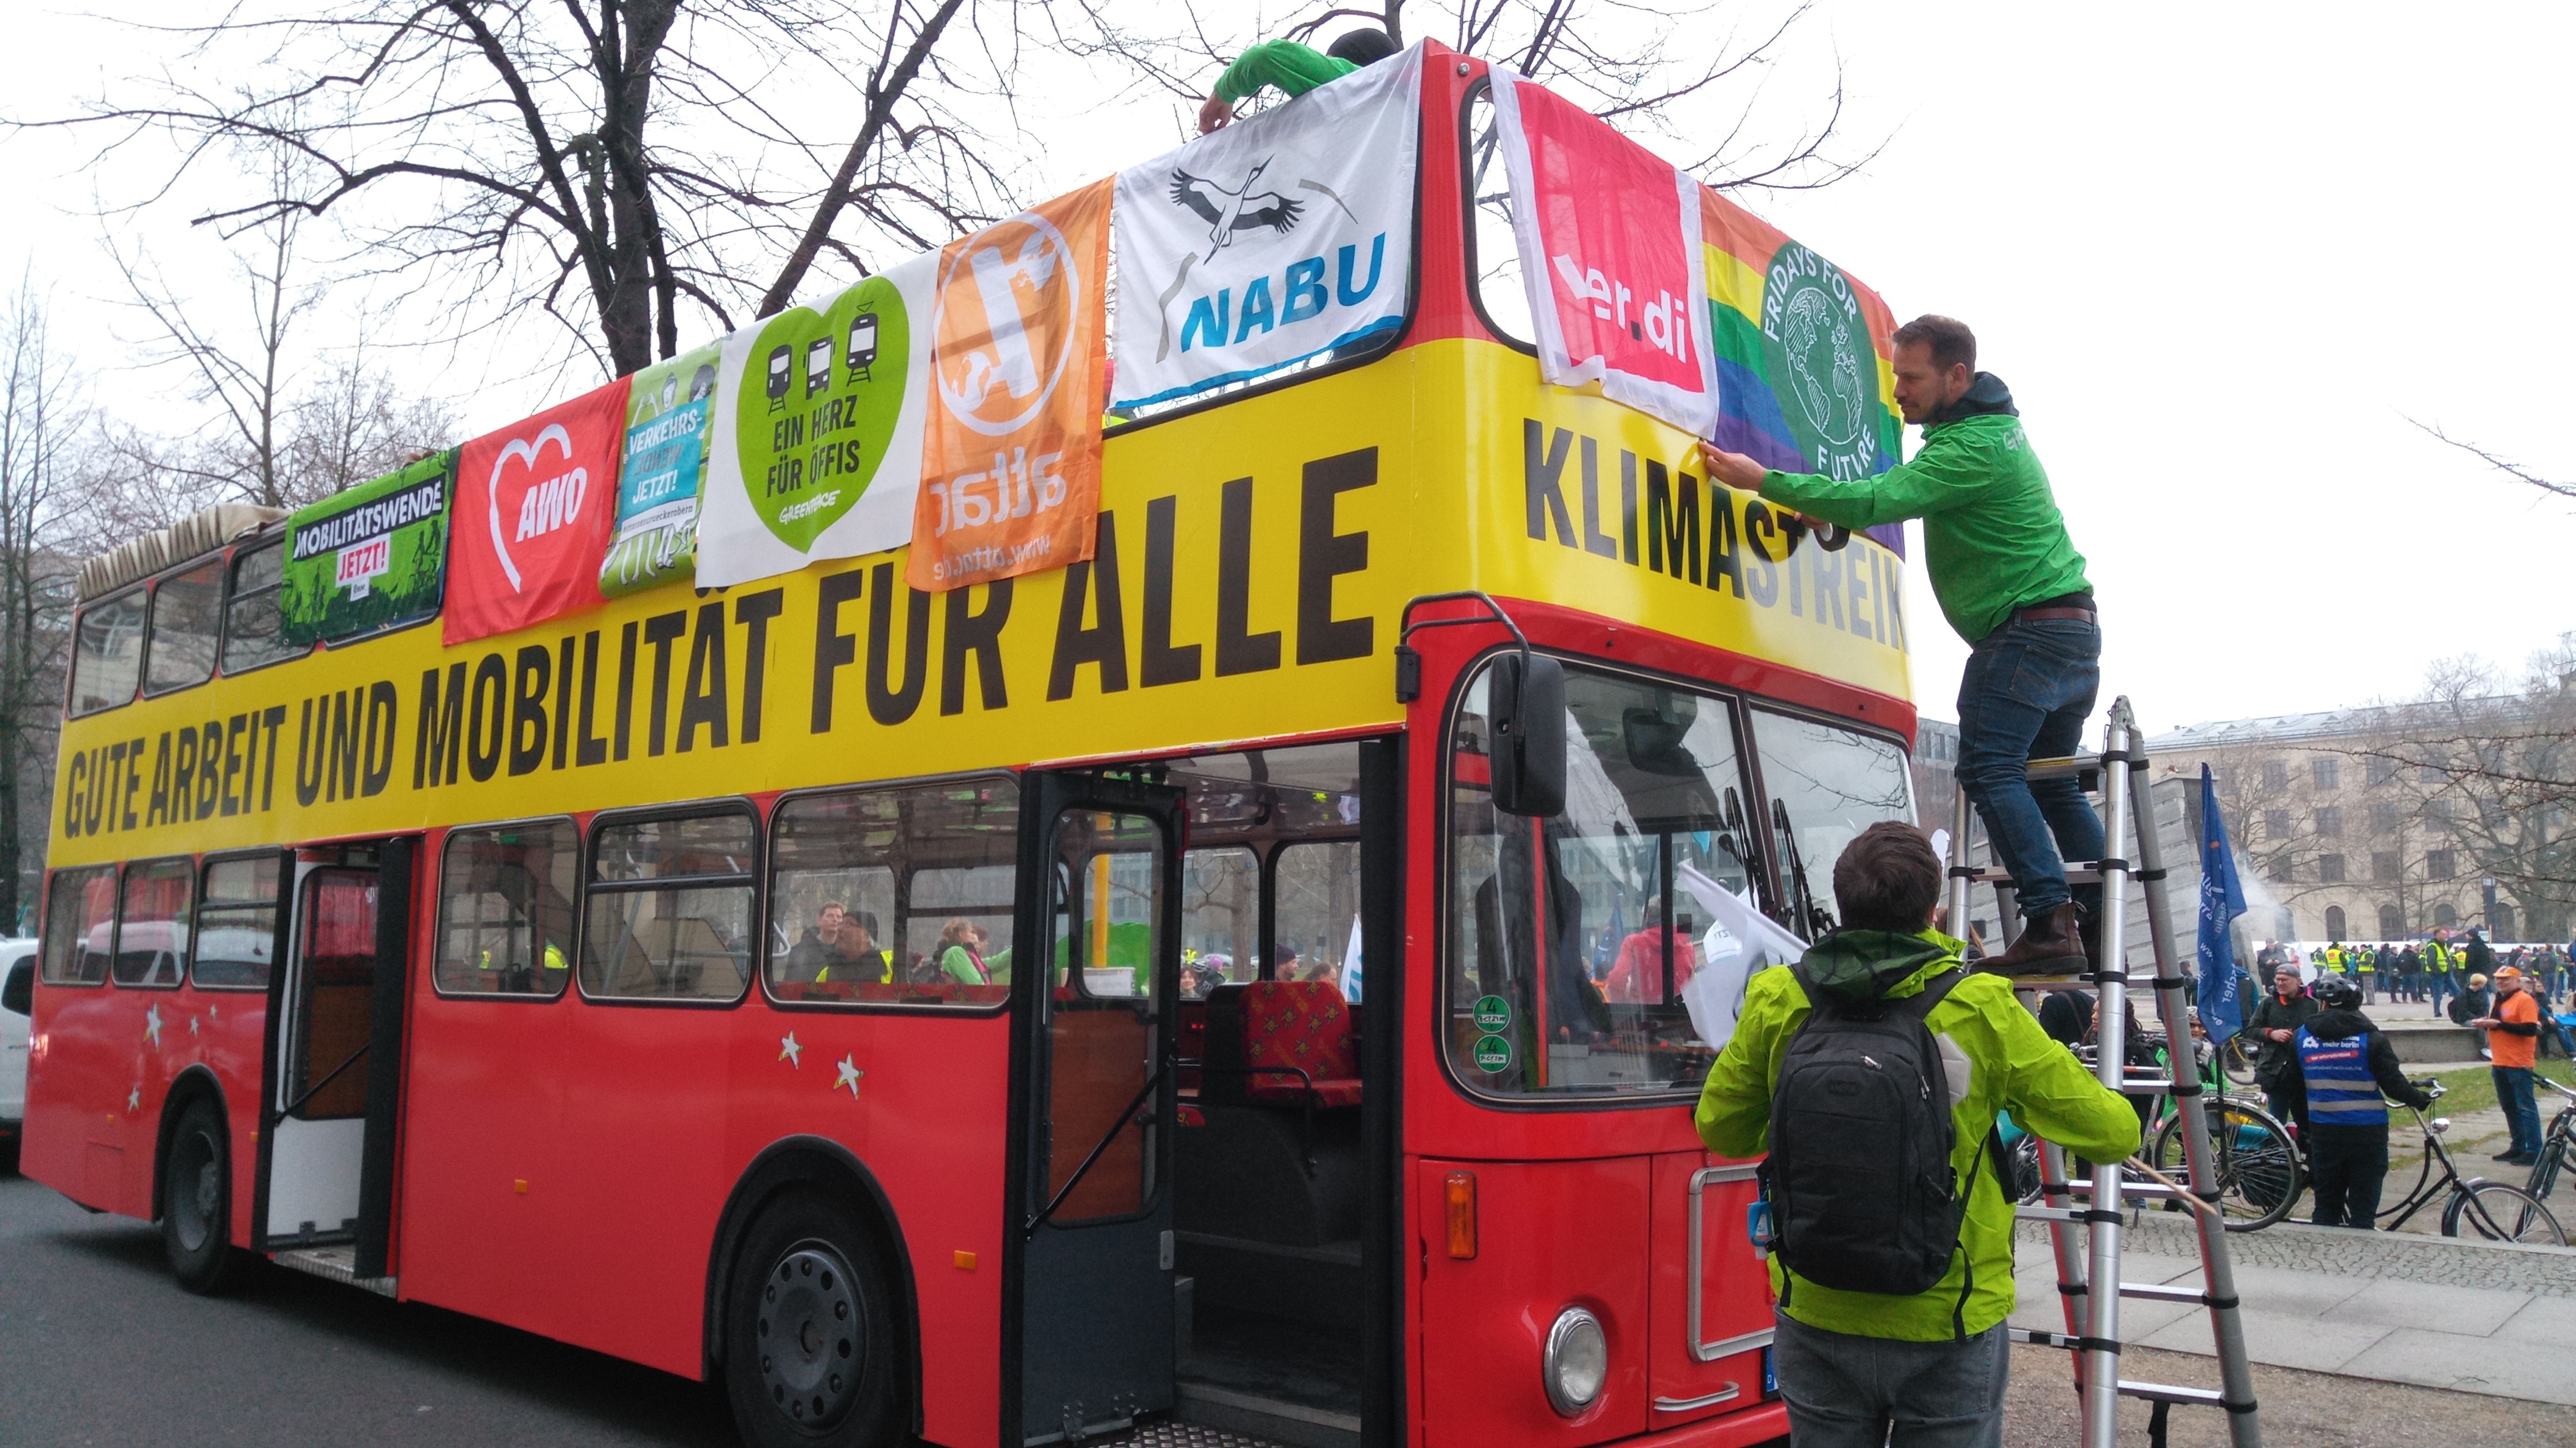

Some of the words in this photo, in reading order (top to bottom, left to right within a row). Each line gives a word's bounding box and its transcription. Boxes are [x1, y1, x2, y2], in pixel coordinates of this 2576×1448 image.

[1180, 231, 1387, 354] NABU
[1552, 254, 1686, 364] ver.di
[1764, 247, 1817, 343] FRIDAYS
[1822, 259, 1858, 323] FOR
[628, 413, 703, 456] VERKEHRS-
[772, 414, 804, 454] EIN
[811, 394, 858, 441] HERZ
[632, 469, 678, 504] JETZT!
[767, 454, 803, 498] FÜR
[809, 440, 861, 485] ÖFFIS
[293, 480, 442, 559] MOBILITÄTSWENDE
[516, 467, 587, 543] AWO
[338, 541, 386, 582] JETZT!
[1523, 417, 1910, 656] KLIMASTREIK
[64, 737, 145, 839] GUTE
[145, 704, 286, 828] ARBEIT
[296, 680, 397, 808] UND
[412, 586, 784, 791] MOBILITÄT
[810, 542, 1014, 735] FÜR
[1045, 445, 1379, 703] ALLE
[1486, 997, 1497, 1014] 4
[1487, 1038, 1498, 1054] 4
[1767, 1375, 1772, 1384] D
